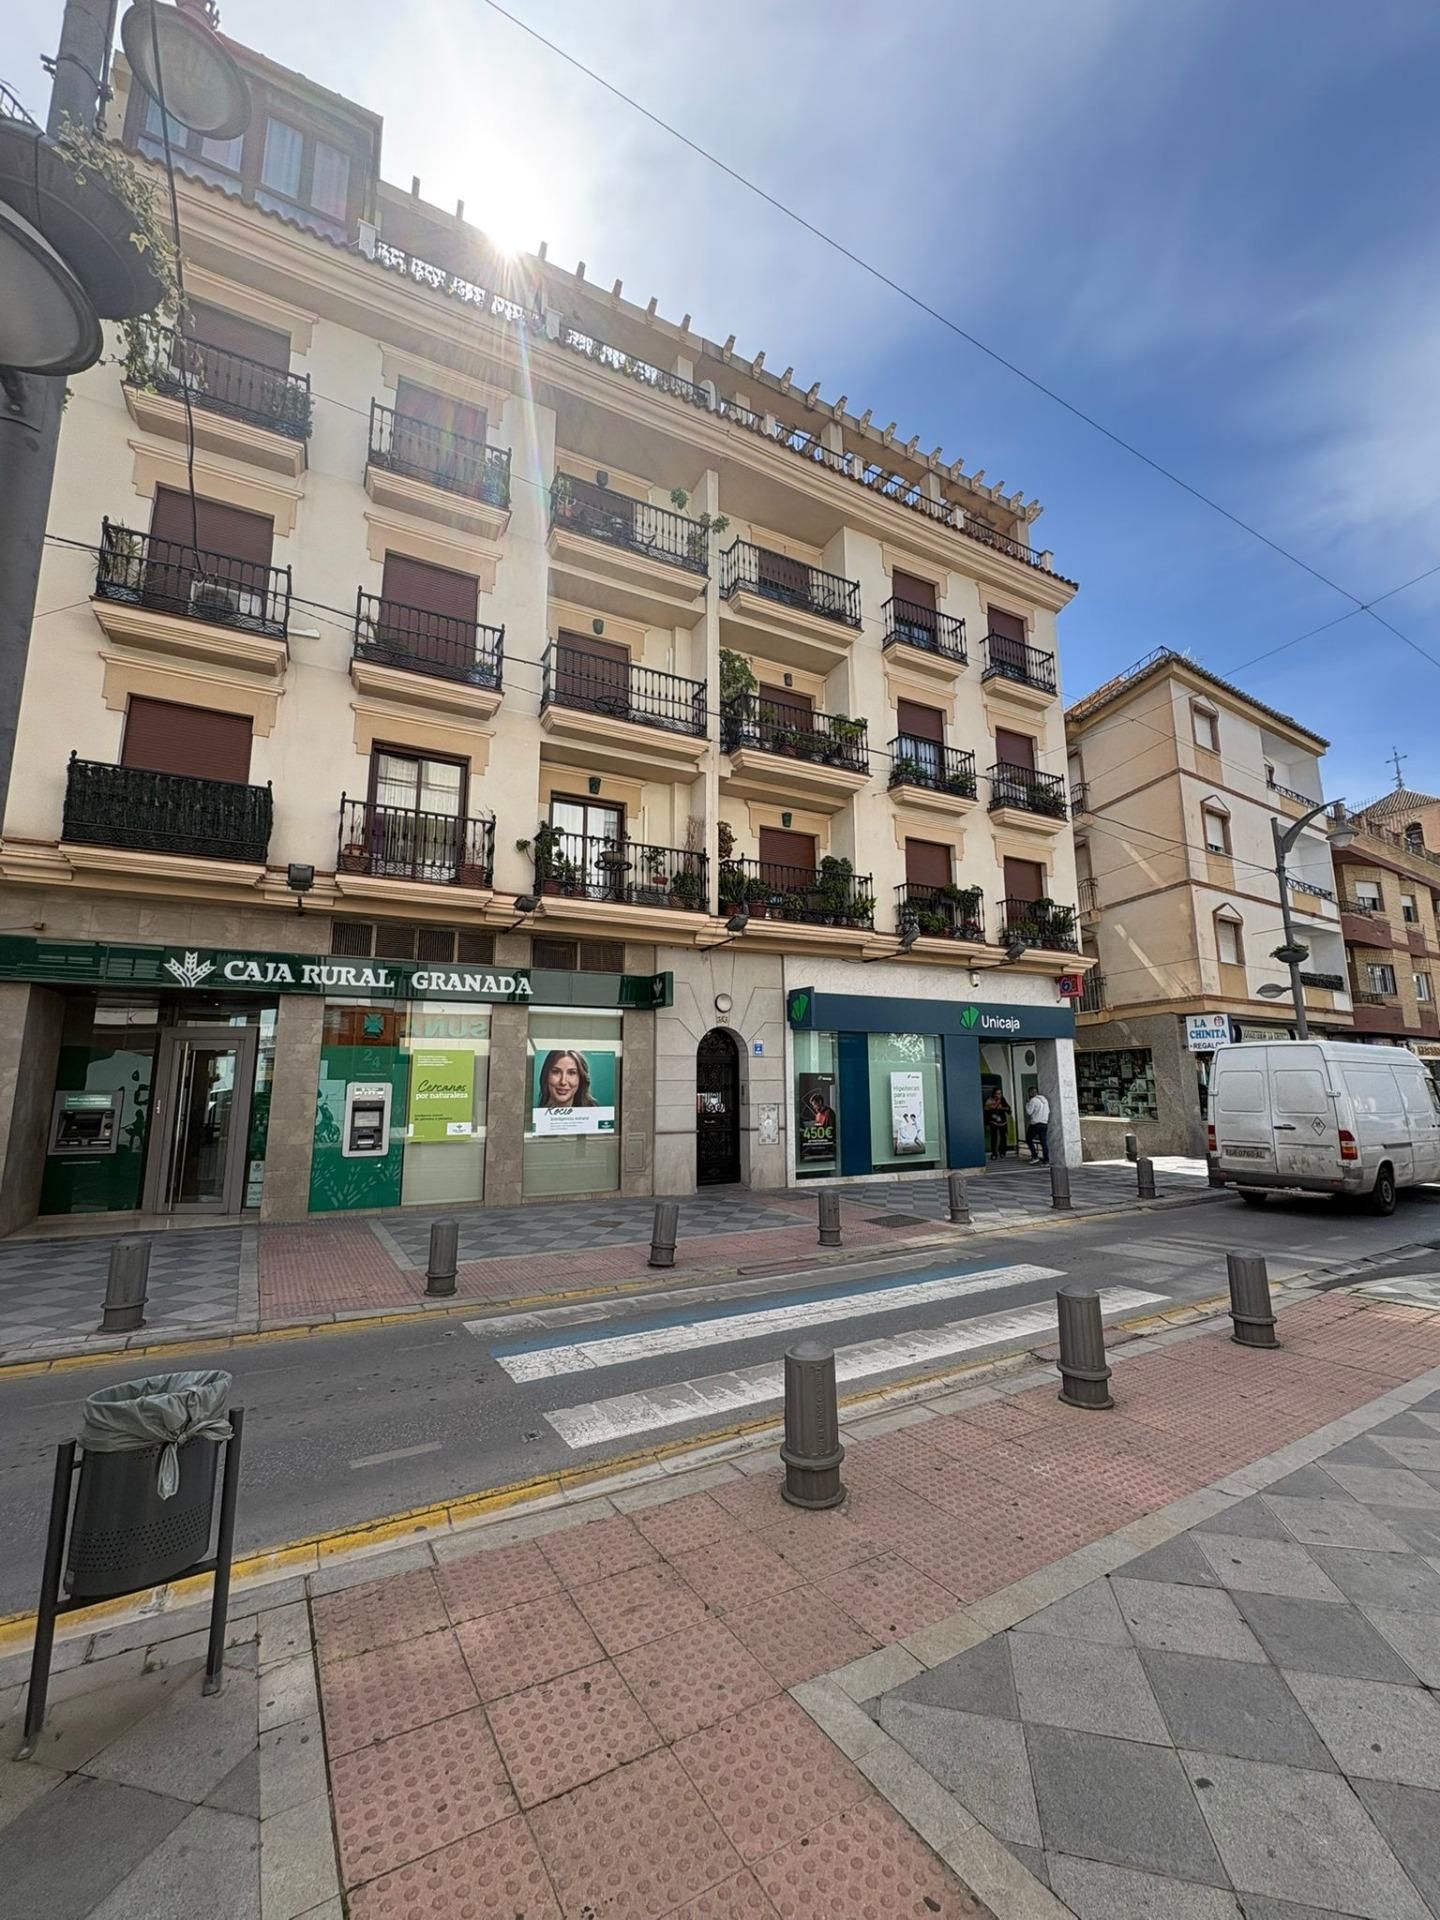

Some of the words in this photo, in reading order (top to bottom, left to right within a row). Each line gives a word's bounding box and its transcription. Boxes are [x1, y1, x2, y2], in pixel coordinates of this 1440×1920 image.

[223, 960, 295, 984] CAJA
[301, 964, 395, 989] RURAL
[411, 971, 534, 996] GRANADA
[981, 1015, 1021, 1033] Unicaja
[1193, 1018, 1207, 1028] LA
[1189, 1029, 1228, 1040] CHINITA
[416, 1079, 467, 1093] Cercanos
[415, 1092, 429, 1101] por
[803, 1126, 833, 1140] 450€
